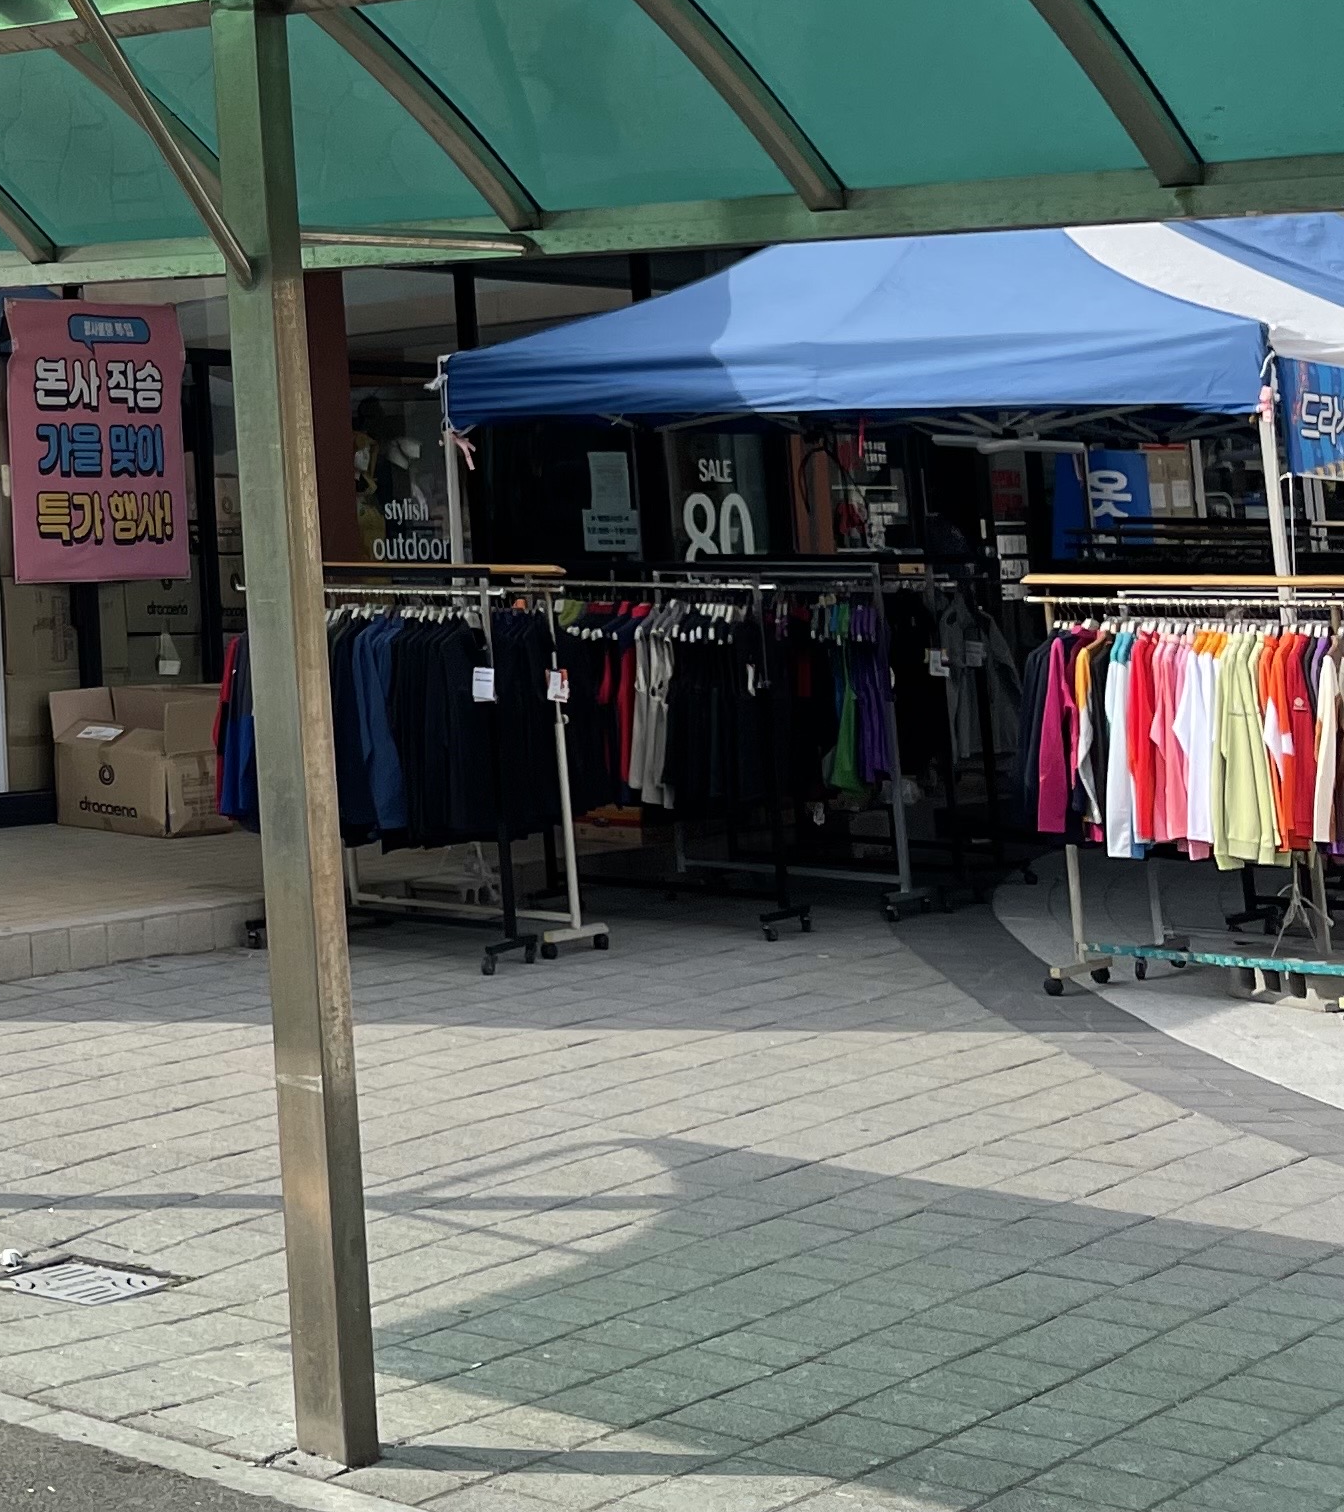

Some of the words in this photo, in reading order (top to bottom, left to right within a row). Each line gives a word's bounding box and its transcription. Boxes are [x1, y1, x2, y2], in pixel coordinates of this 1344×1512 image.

[34, 357, 101, 411] 본사
[106, 358, 164, 413] 직송
[1300, 391, 1344, 445] 드라
[35, 422, 103, 477] 가을
[109, 423, 164, 477] 맞이
[697, 457, 734, 483] SALE
[35, 491, 105, 546] 특가
[108, 490, 174, 545] 행사!
[384, 497, 429, 526] stylish
[372, 531, 450, 561] outdoor
[79, 795, 138, 819] dracaena
